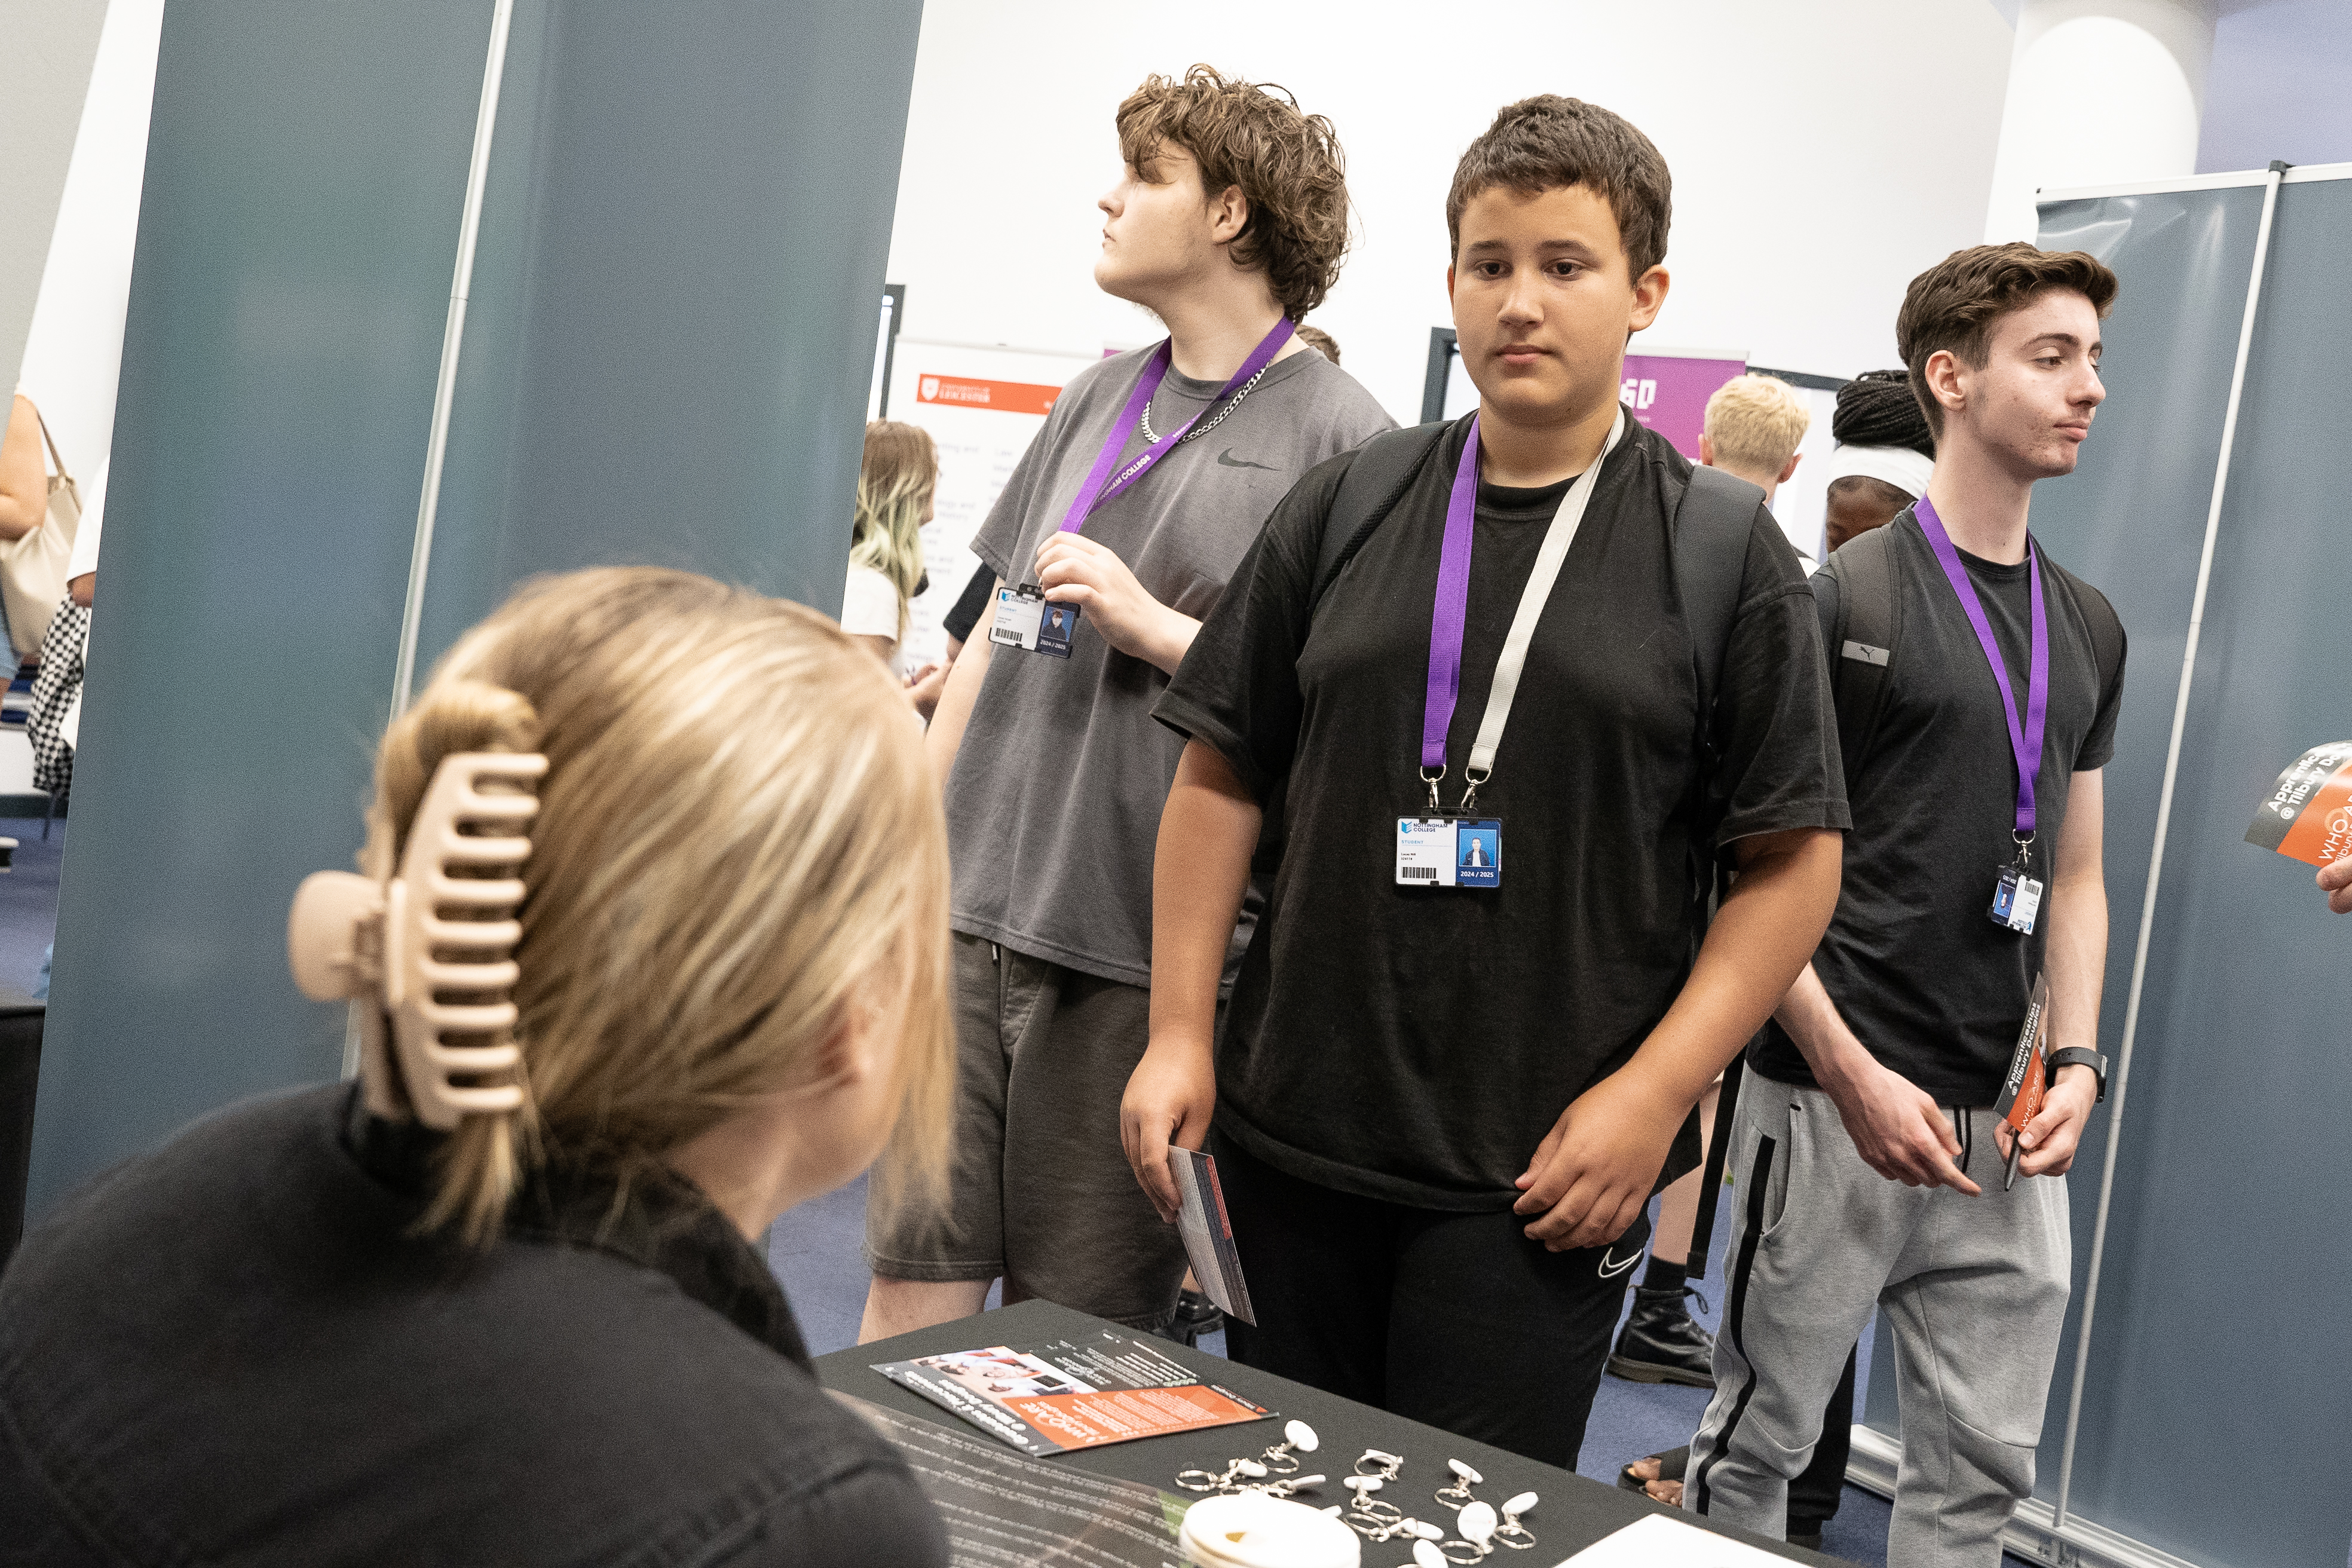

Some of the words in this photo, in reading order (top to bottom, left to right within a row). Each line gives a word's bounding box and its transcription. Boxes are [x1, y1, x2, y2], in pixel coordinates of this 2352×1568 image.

[1122, 454, 1152, 480] COLLEGE
[2287, 767, 2326, 805] Tilbury
[2318, 819, 2349, 859] WHO
[2008, 1002, 2036, 1089] Apprenticeships
[2015, 1049, 2029, 1085] Tilbury
[2021, 1097, 2034, 1127] WHO
